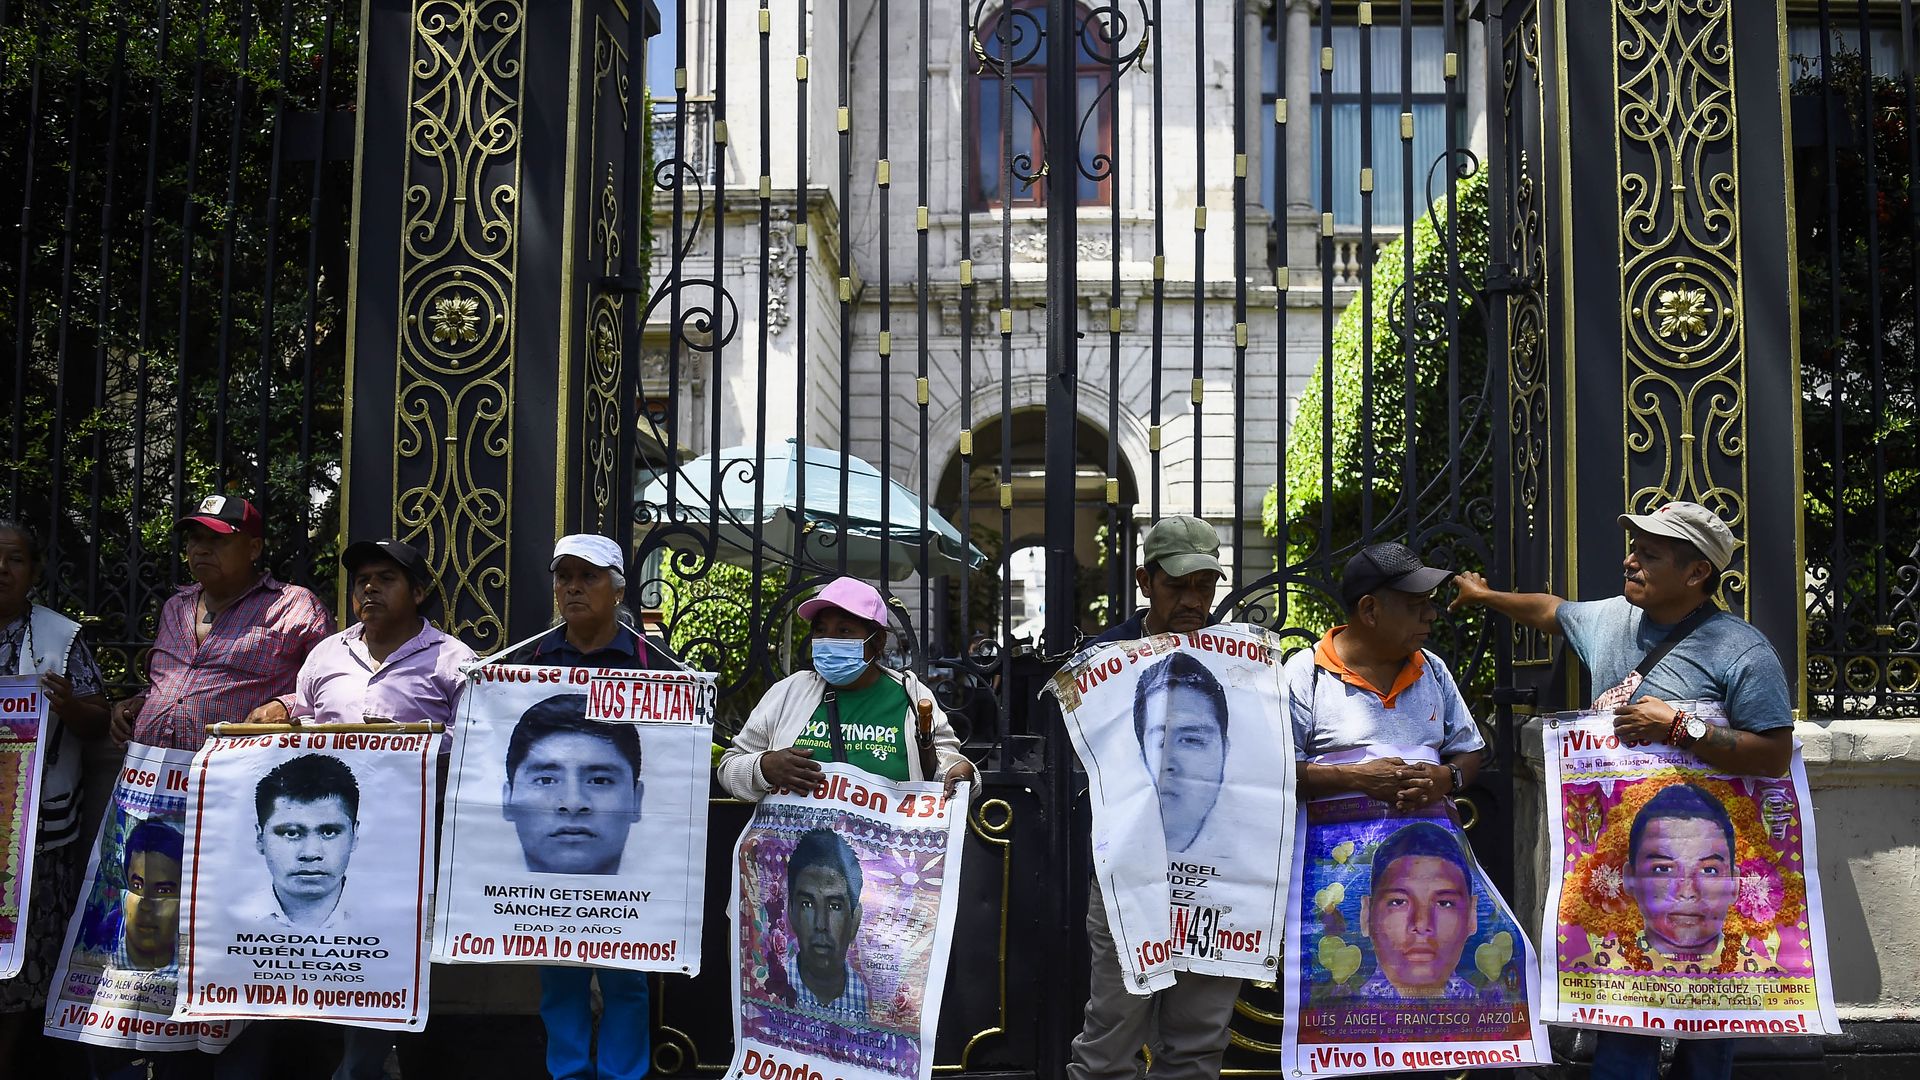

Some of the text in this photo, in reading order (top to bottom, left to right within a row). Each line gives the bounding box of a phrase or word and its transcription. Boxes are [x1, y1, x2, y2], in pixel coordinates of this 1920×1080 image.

[1127, 643, 1152, 664] se
[537, 668, 562, 683] se
[569, 667, 589, 685] lo
[0, 693, 37, 712] on!
[588, 680, 716, 725] NOS FALTAN 43
[279, 734, 301, 749] se
[307, 733, 327, 749] lo
[333, 733, 422, 752] llevaron!
[855, 742, 862, 750] el
[1563, 730, 1620, 757] ¡Vivo
[872, 749, 888, 761] 43
[801, 775, 946, 819] altan 43!
[1168, 861, 1222, 877] NGEL
[1167, 872, 1208, 888] DEZ
[484, 884, 651, 903] MARTÍN GETSEMANY
[1170, 888, 1196, 901] EZ
[493, 901, 639, 919] SÁNCHEZ GARCÍA
[514, 923, 622, 935] EDAD 20 AÑOS
[236, 933, 380, 946] MAGDALENO
[452, 932, 677, 962] ¡Con VIDA lo queremos!
[227, 945, 389, 959] RUBÉN LAURO
[252, 959, 362, 971] VILLEGAS
[253, 971, 365, 983] EDAD 19 AÑOS
[1563, 977, 1811, 994] CHRISTIAN ALFONSO RODRÍGUEZ TELUMBRE
[199, 982, 407, 1010] ¡Con VIDA lo queremos!
[1570, 991, 1592, 1000] Hijo
[1596, 991, 1607, 1000] de
[1612, 993, 1655, 1003] Clemente
[1660, 996, 1665, 1005] y
[1670, 996, 1687, 1005] Luz
[1768, 997, 1778, 1005] 19
[1783, 996, 1805, 1006] años
[101, 1010, 114, 1030] lo
[117, 1016, 231, 1039] queremos!
[1305, 1011, 1526, 1027] LUÍS ÁNGEL FRANCISCO ARZOLA
[810, 1024, 841, 1041] ORTEGA
[846, 1033, 886, 1050] VALERIO
[1309, 1044, 1522, 1073] ¡Vivo lo queremos!
